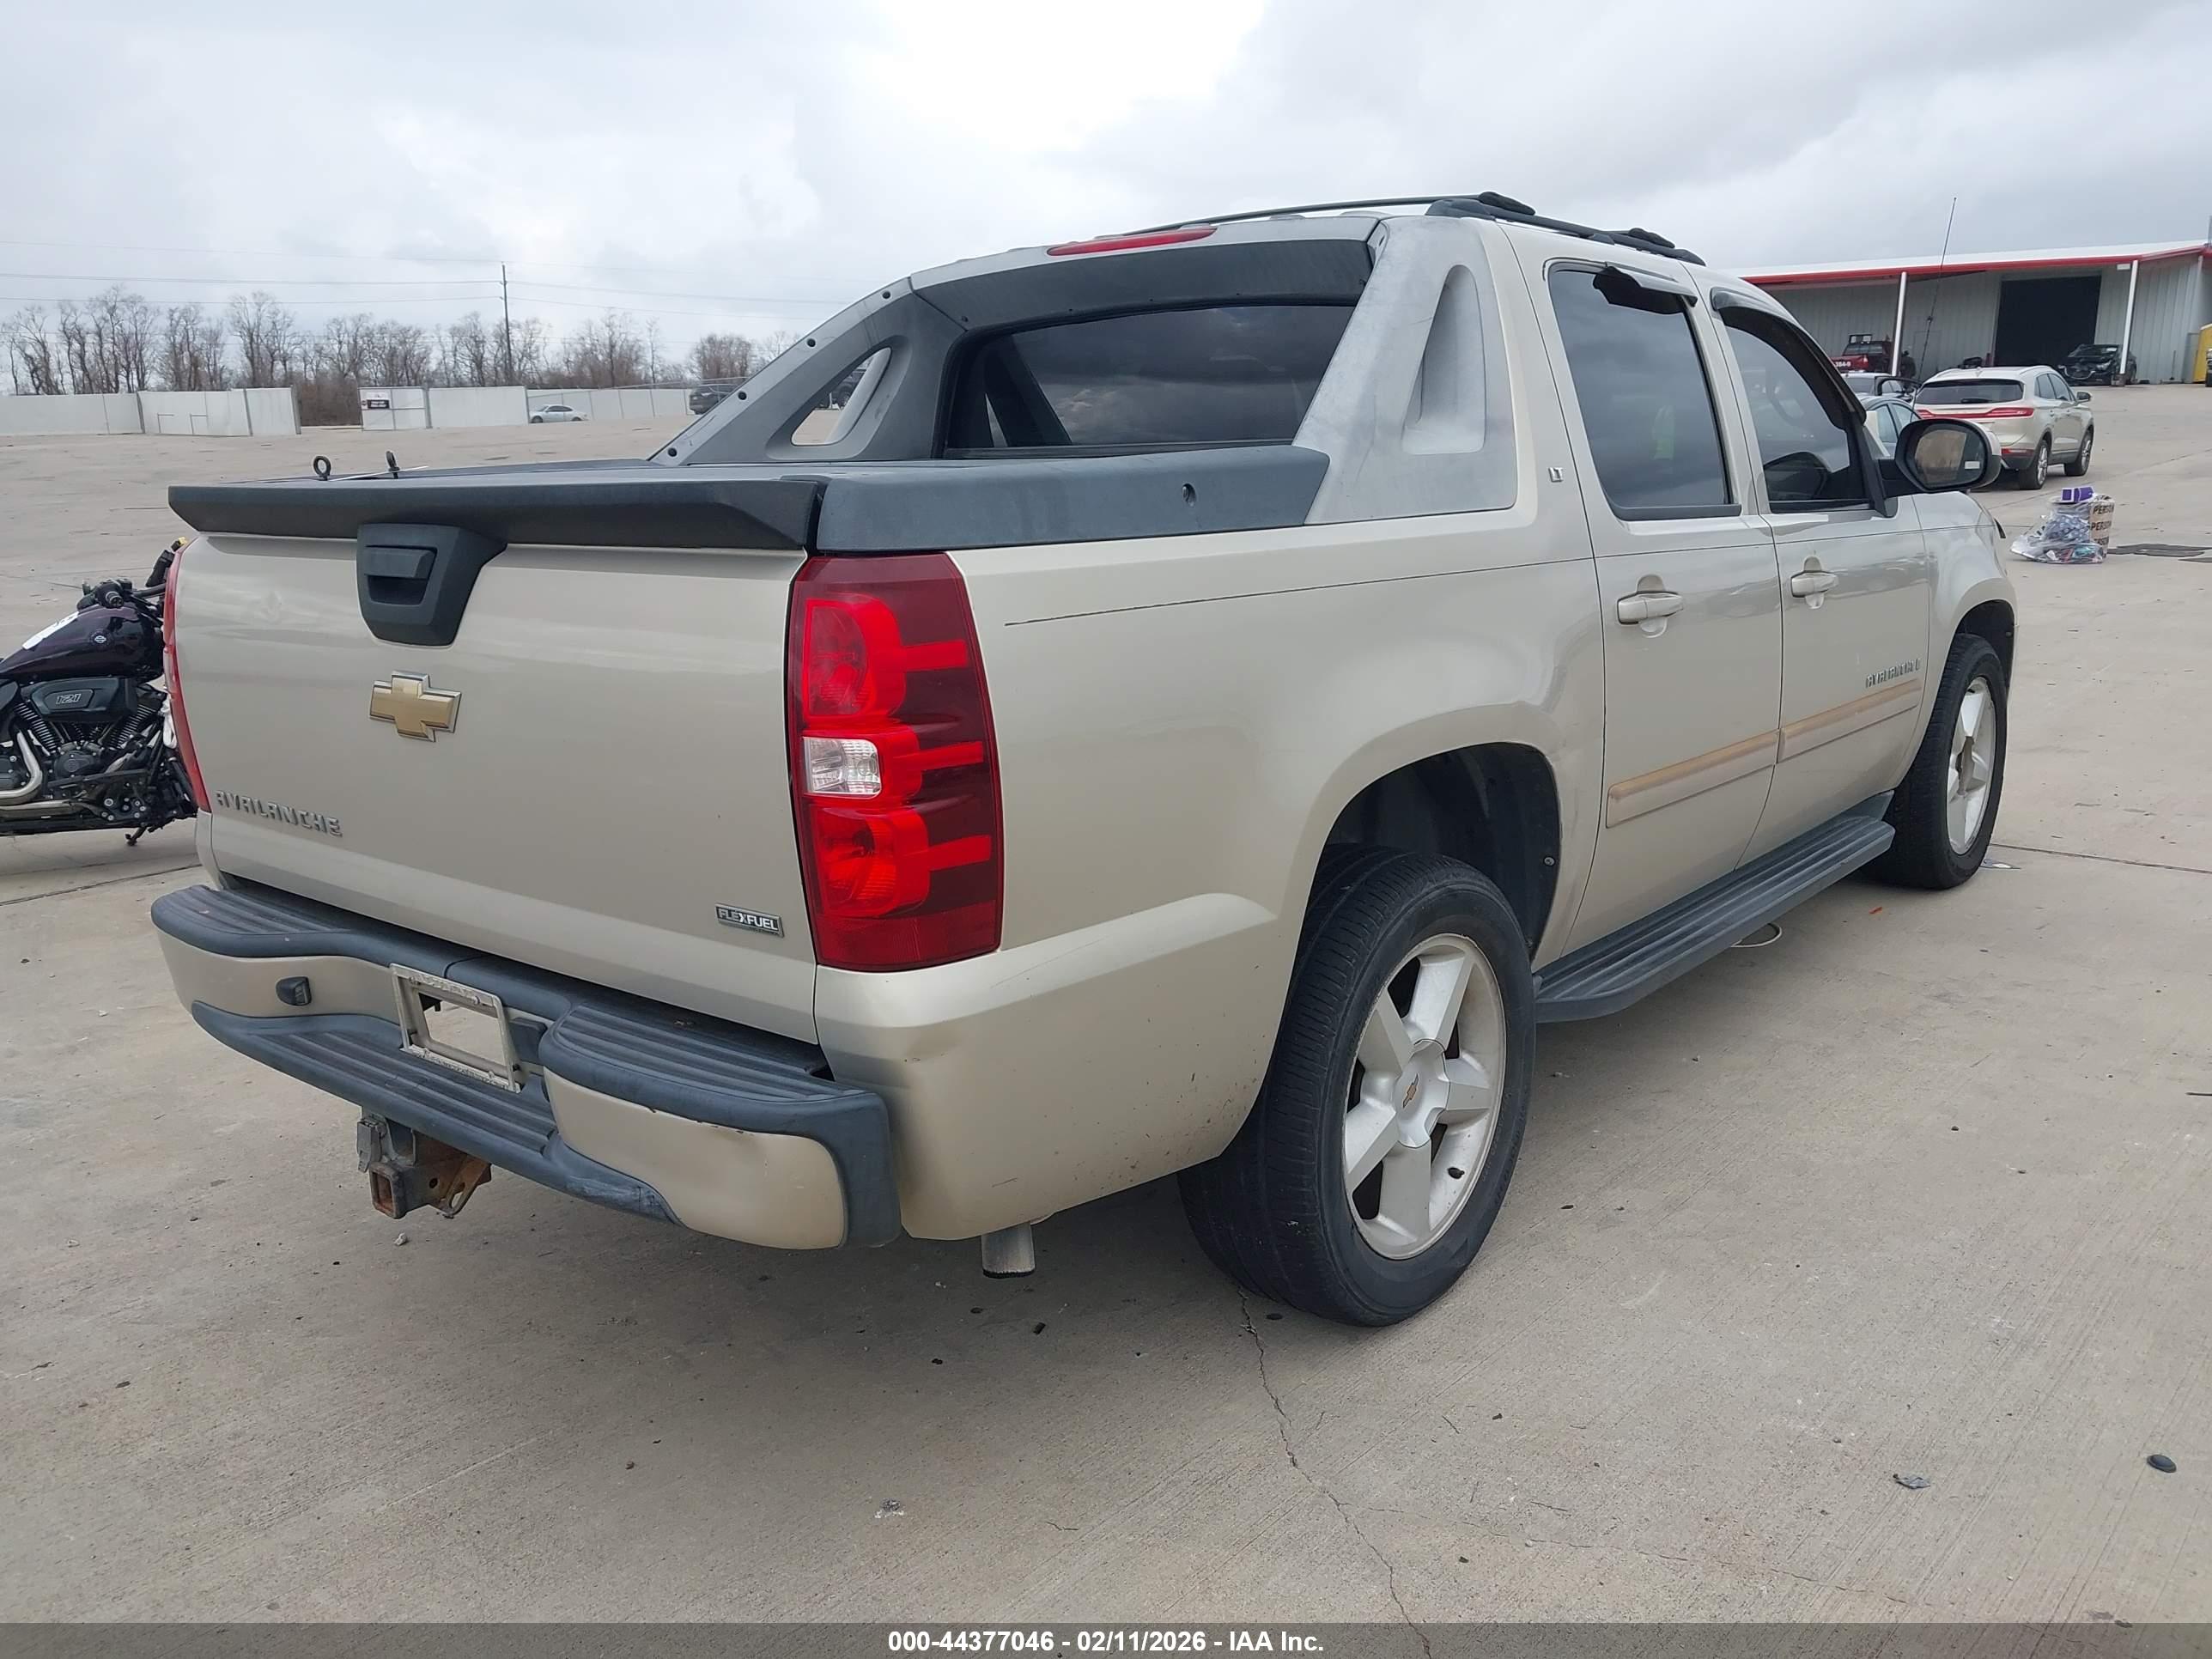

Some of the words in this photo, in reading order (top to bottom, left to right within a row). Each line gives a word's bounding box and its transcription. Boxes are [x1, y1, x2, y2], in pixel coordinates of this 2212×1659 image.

[1547, 466, 1564, 483] LT
[56, 692, 82, 705] 121
[215, 789, 343, 838] AVALANCHE
